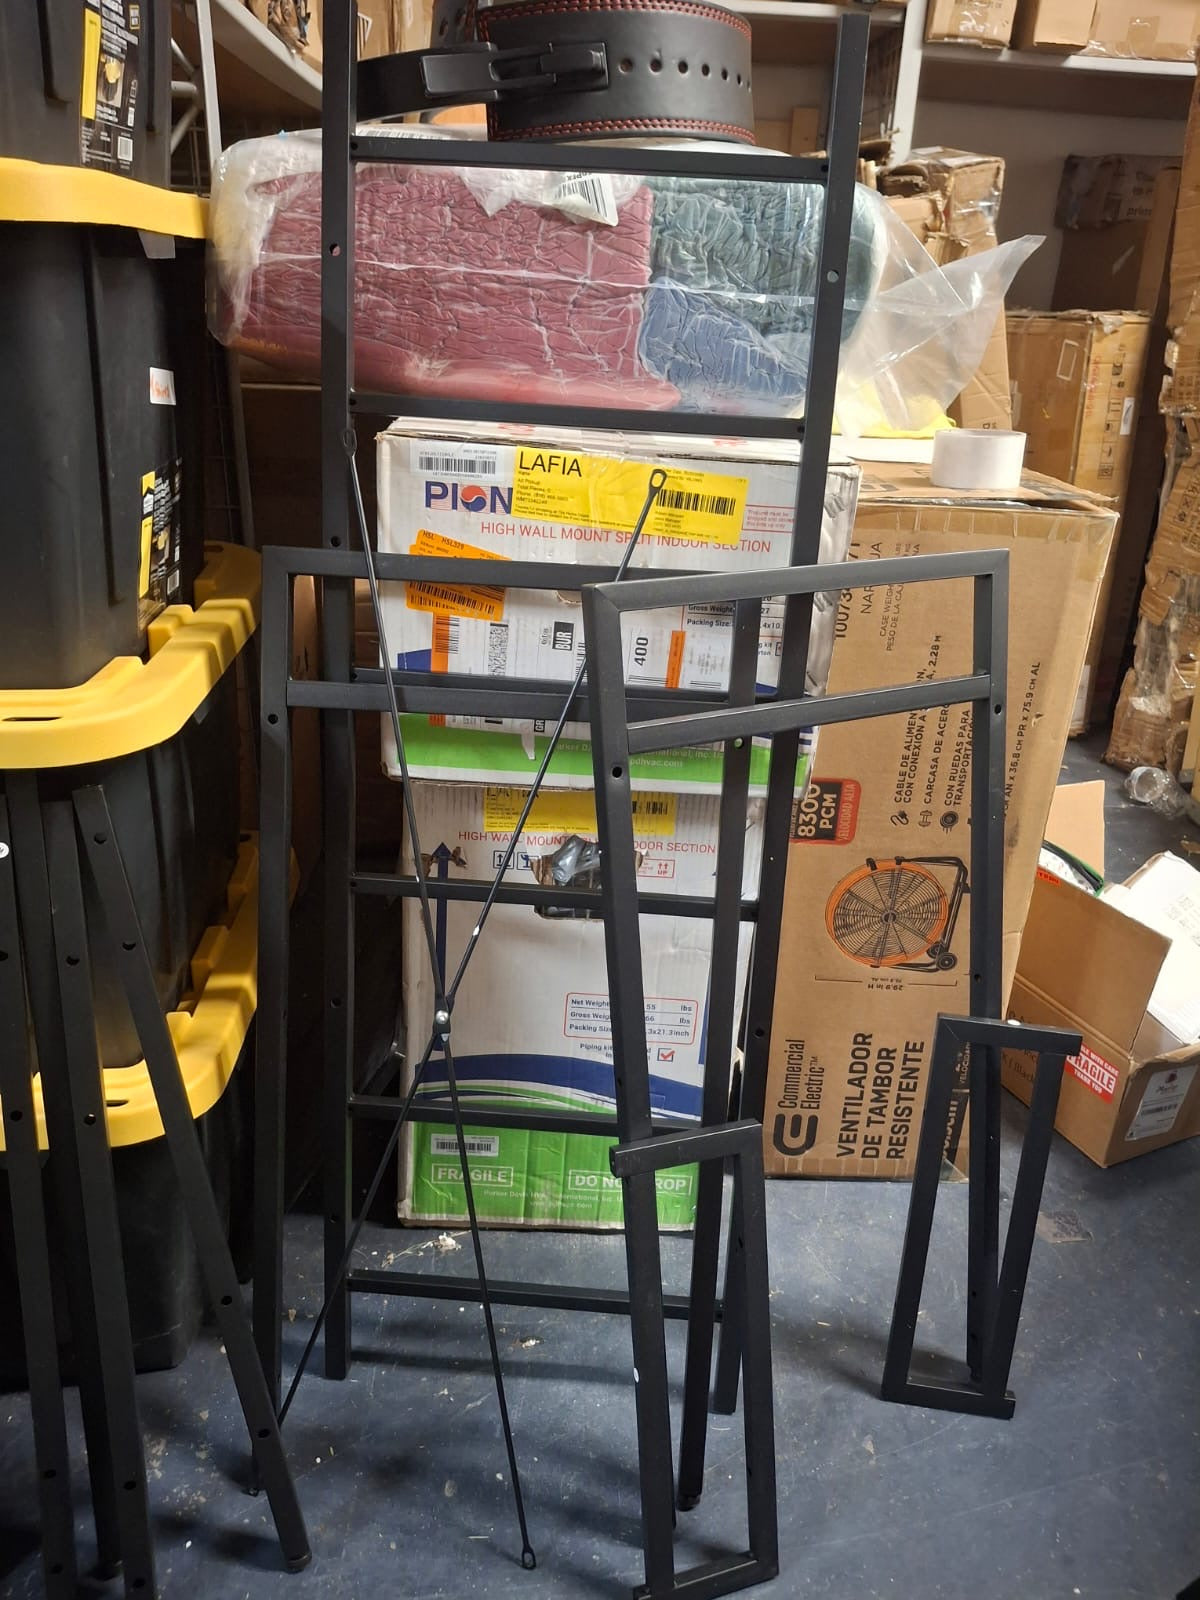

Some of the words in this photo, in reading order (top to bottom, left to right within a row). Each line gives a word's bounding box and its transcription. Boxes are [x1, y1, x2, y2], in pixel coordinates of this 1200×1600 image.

[519, 451, 582, 477] LAFIA
[481, 522, 515, 536] HIGH
[519, 525, 557, 539] WALL
[561, 527, 611, 542] MOUNT
[884, 584, 894, 613] WEIGH
[893, 604, 900, 615] LA
[687, 618, 714, 628] Packing
[890, 616, 898, 629] DE
[554, 631, 572, 650] BUR
[634, 637, 649, 667] 400
[887, 631, 896, 652] PESO
[927, 644, 940, 668] 2.28
[1016, 724, 1027, 737] PR
[1031, 661, 1041, 677] AL
[957, 709, 971, 744] PARA
[903, 786, 912, 804] CON
[919, 714, 927, 724] A
[923, 756, 939, 804] CARCASA
[933, 739, 944, 754] DE
[948, 747, 964, 786] RUEDAS
[893, 776, 905, 803] CABLE
[899, 754, 909, 769] DE
[845, 784, 857, 802] ALTA
[944, 786, 954, 806] CON
[797, 784, 821, 837] 8300
[819, 793, 837, 829] PCM
[840, 802, 853, 840] VELOCIDAD
[458, 831, 488, 841] HIGH
[633, 841, 663, 851] DOOR
[667, 843, 716, 854] SECTION
[569, 1023, 597, 1032] Packing
[580, 1042, 602, 1052] Piping
[777, 1039, 806, 1109] Commercial
[866, 1047, 898, 1127] TAMBOR
[836, 1032, 873, 1158] VENTILADOR
[886, 1040, 925, 1160] RESISTENTE
[861, 1135, 883, 1159] DE
[575, 1174, 596, 1187] DO
[602, 1176, 623, 1189] NO
[655, 1177, 687, 1191] ROP
